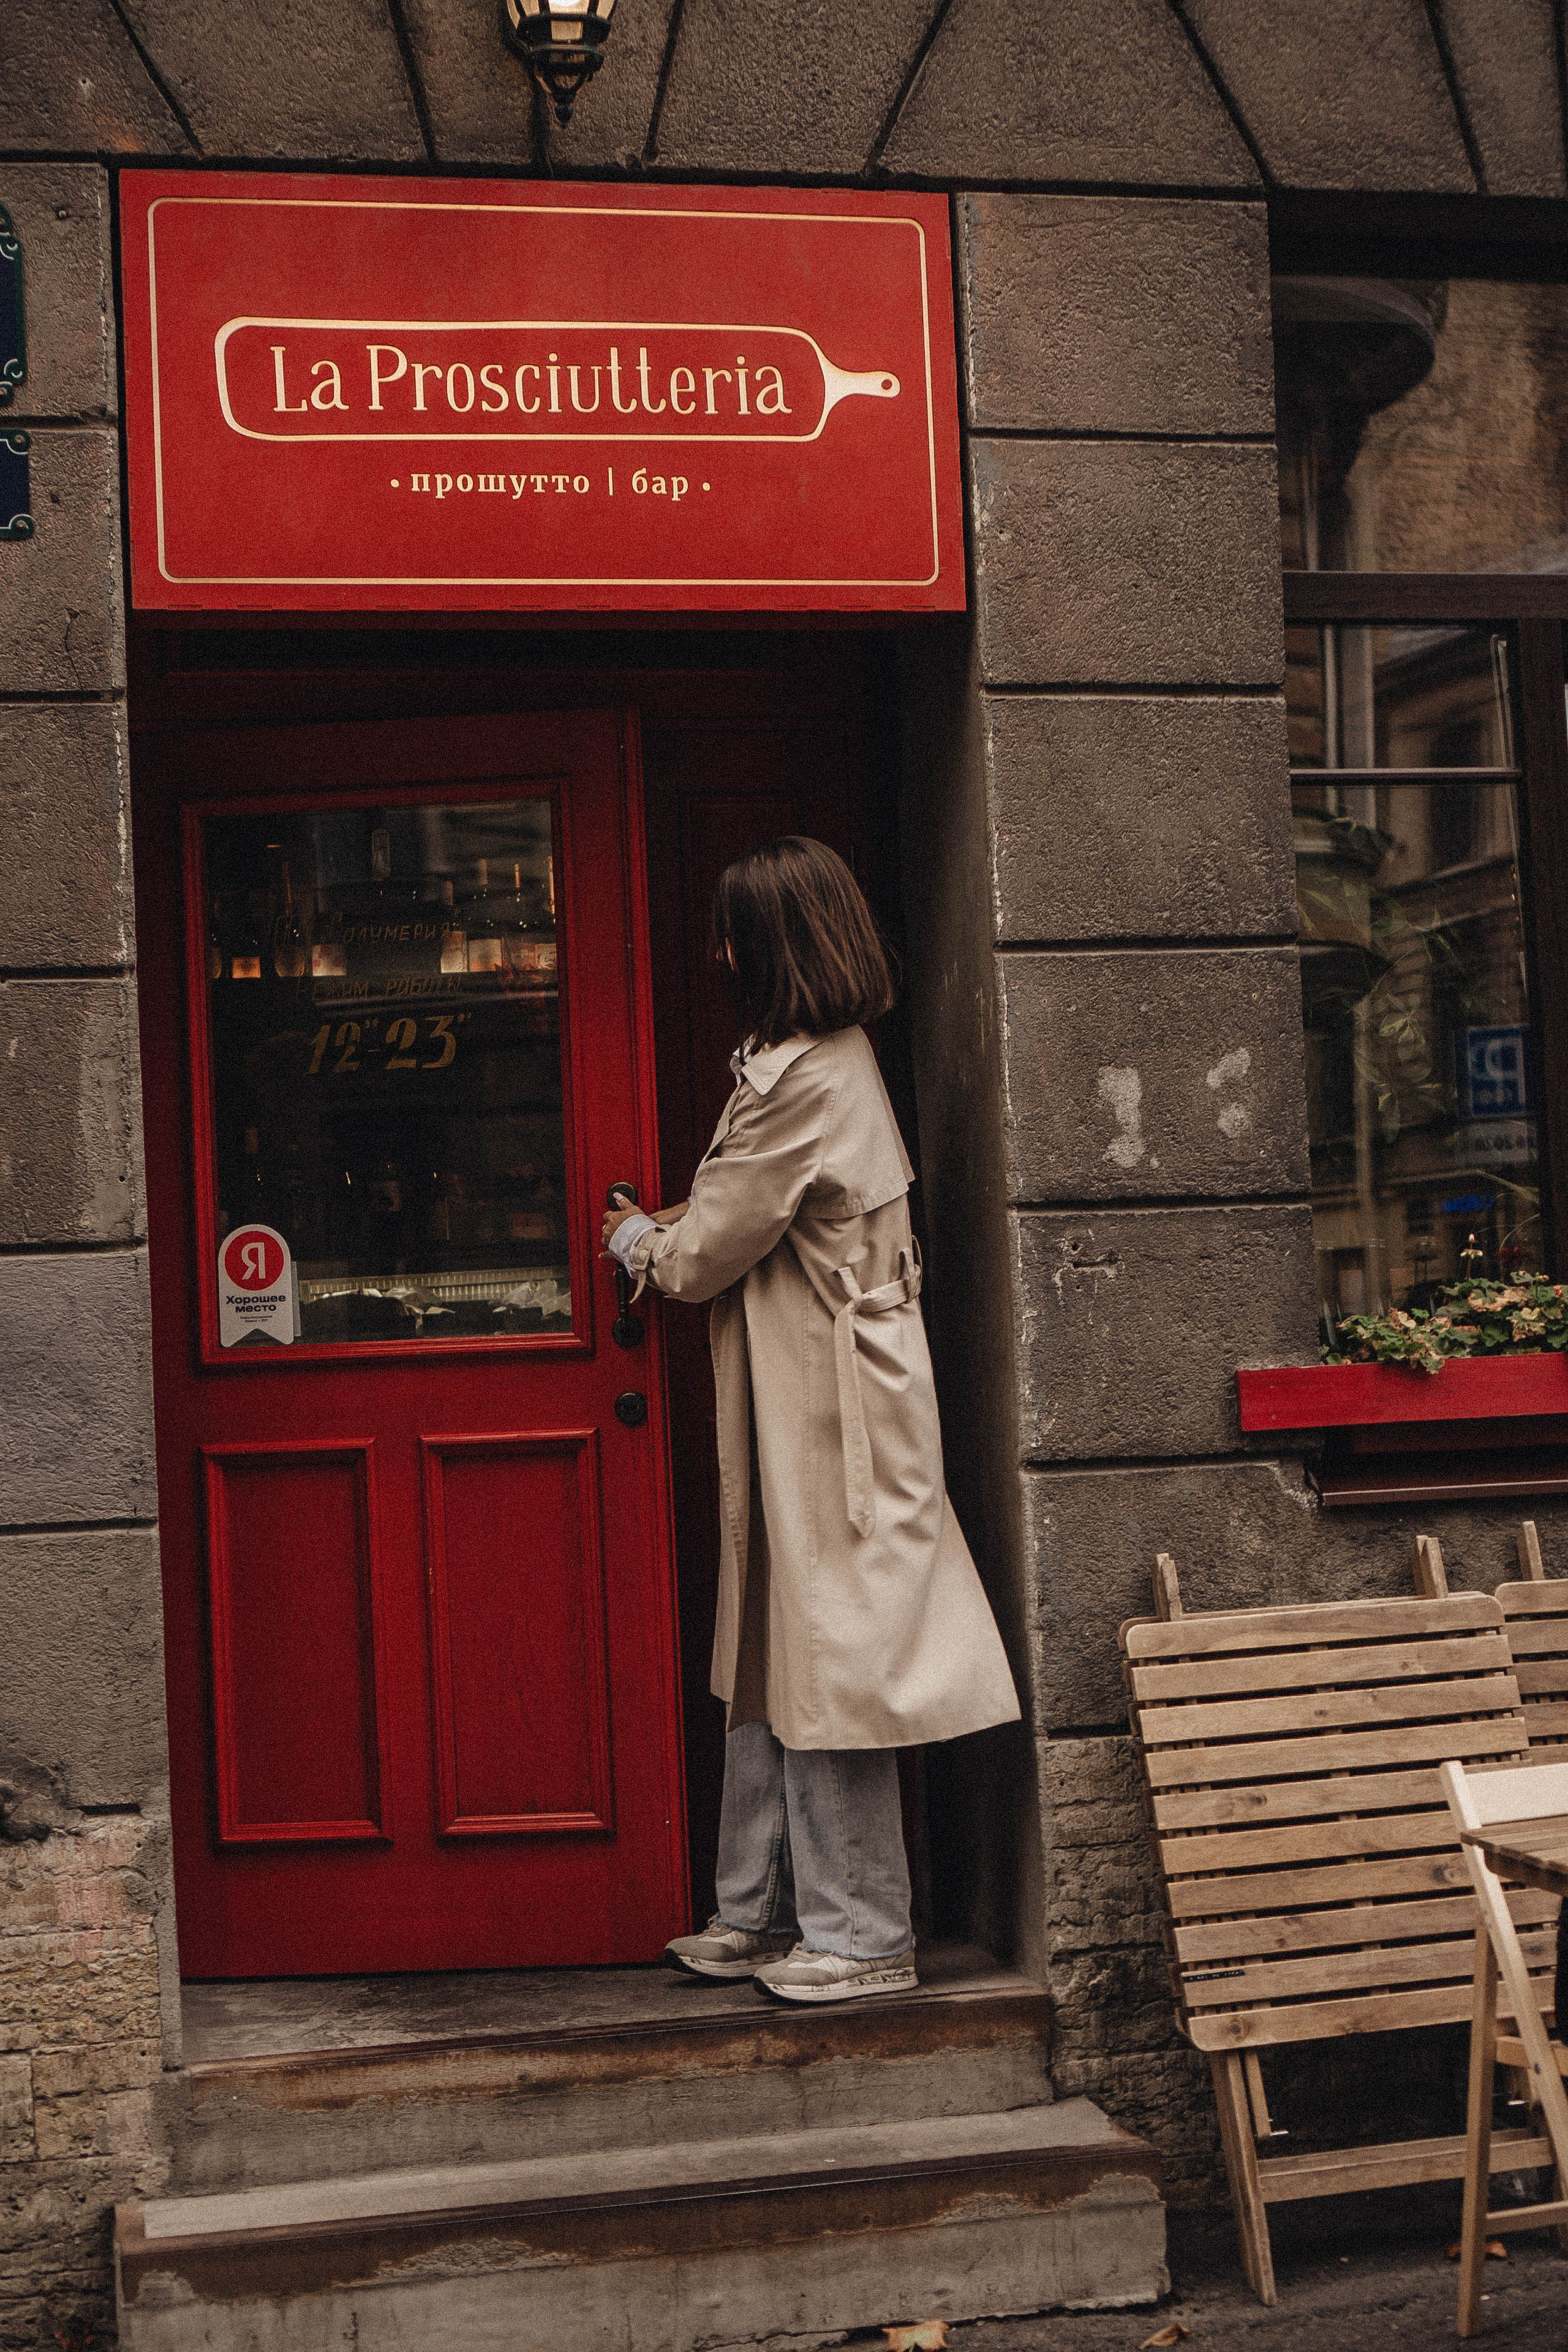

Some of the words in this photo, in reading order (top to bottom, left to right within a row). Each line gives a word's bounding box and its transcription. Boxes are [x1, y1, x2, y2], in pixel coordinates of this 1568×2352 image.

[270, 346, 350, 412] La
[366, 345, 793, 415] Prosciutteria
[410, 473, 590, 500] прошутто
[631, 467, 688, 502] бар
[241, 1242, 266, 1280] Я
[225, 1294, 287, 1306] Хорошее
[235, 1303, 277, 1313] место
